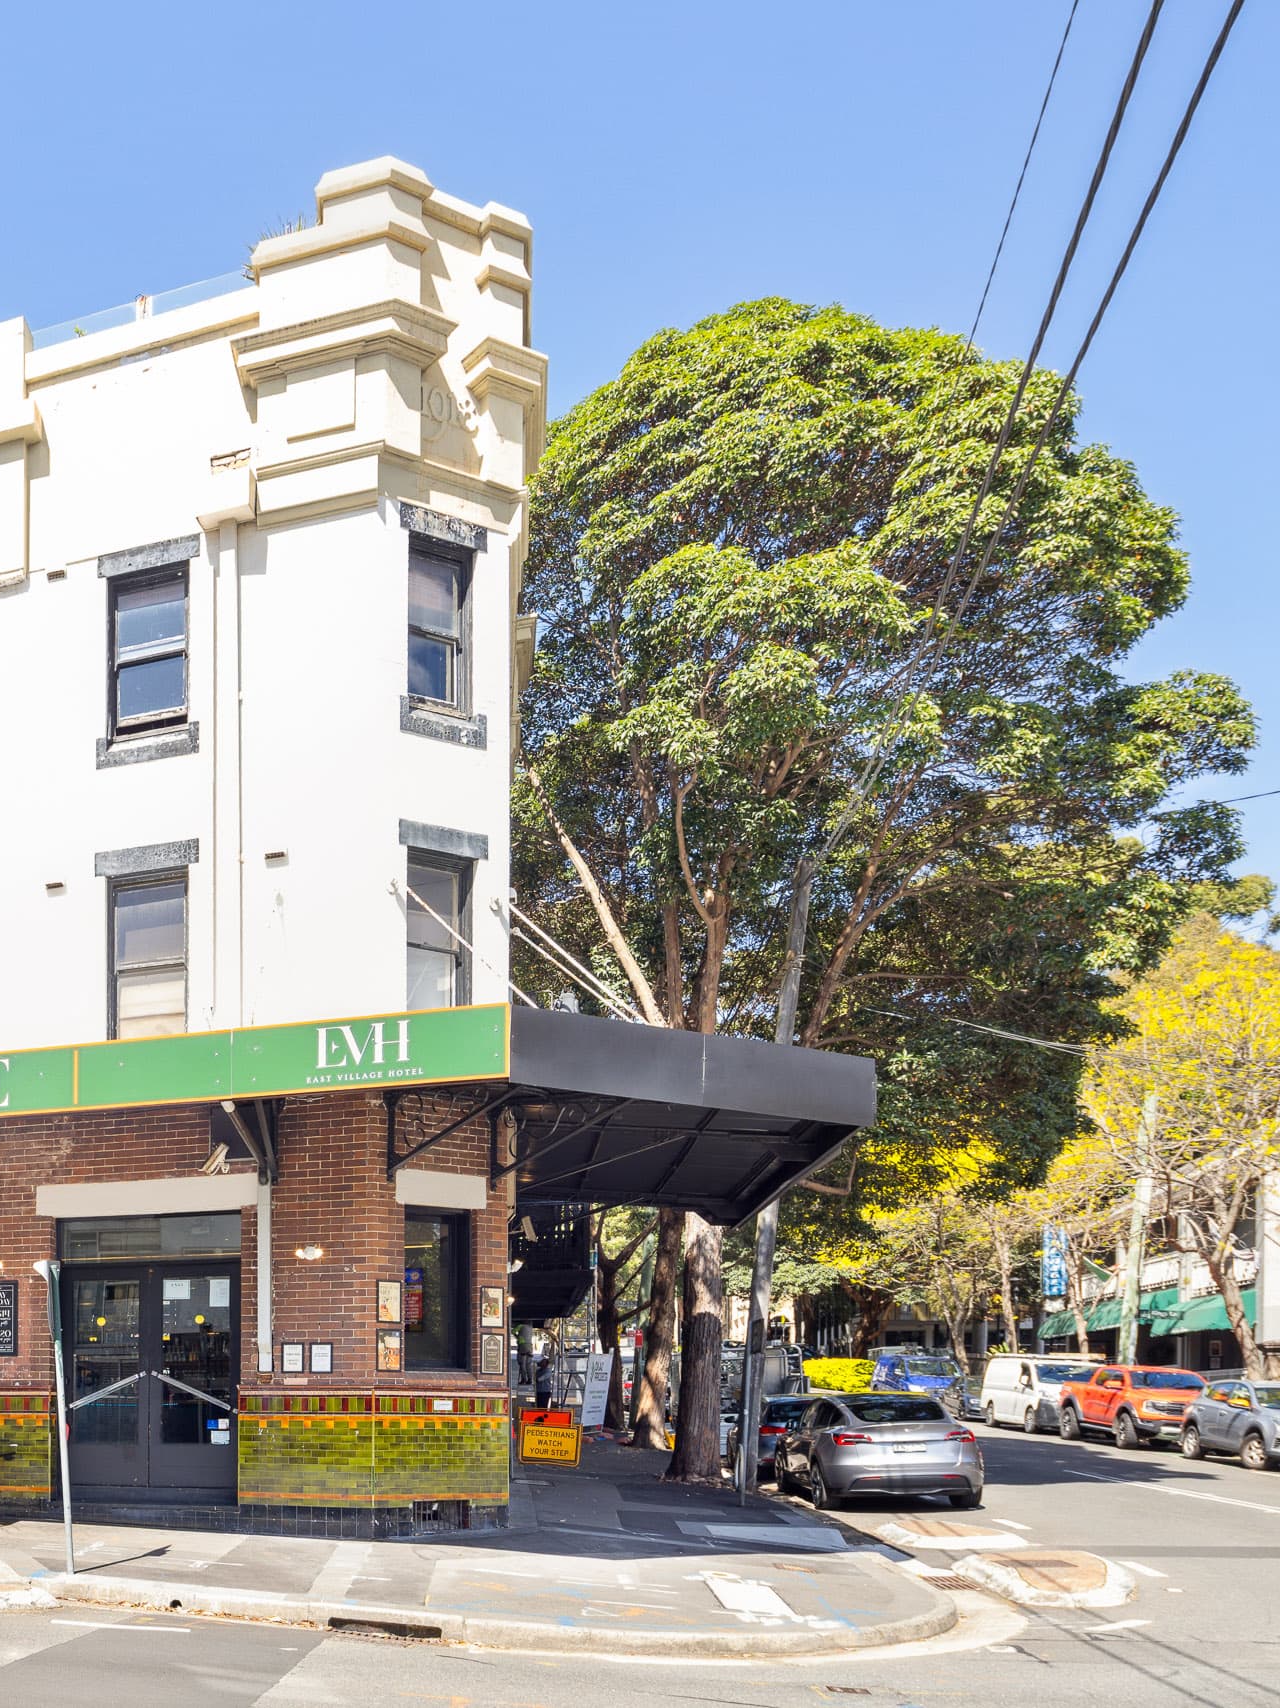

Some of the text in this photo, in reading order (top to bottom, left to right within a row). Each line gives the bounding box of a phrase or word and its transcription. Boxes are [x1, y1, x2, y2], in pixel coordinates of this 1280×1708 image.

[315, 1019, 411, 1069] EVH
[306, 1066, 425, 1085] EAST VILLAGE HOTEL
[526, 1429, 575, 1439] PEDESTRIANS
[537, 1439, 563, 1447] WATCH
[529, 1447, 569, 1457] YOUR STEP
